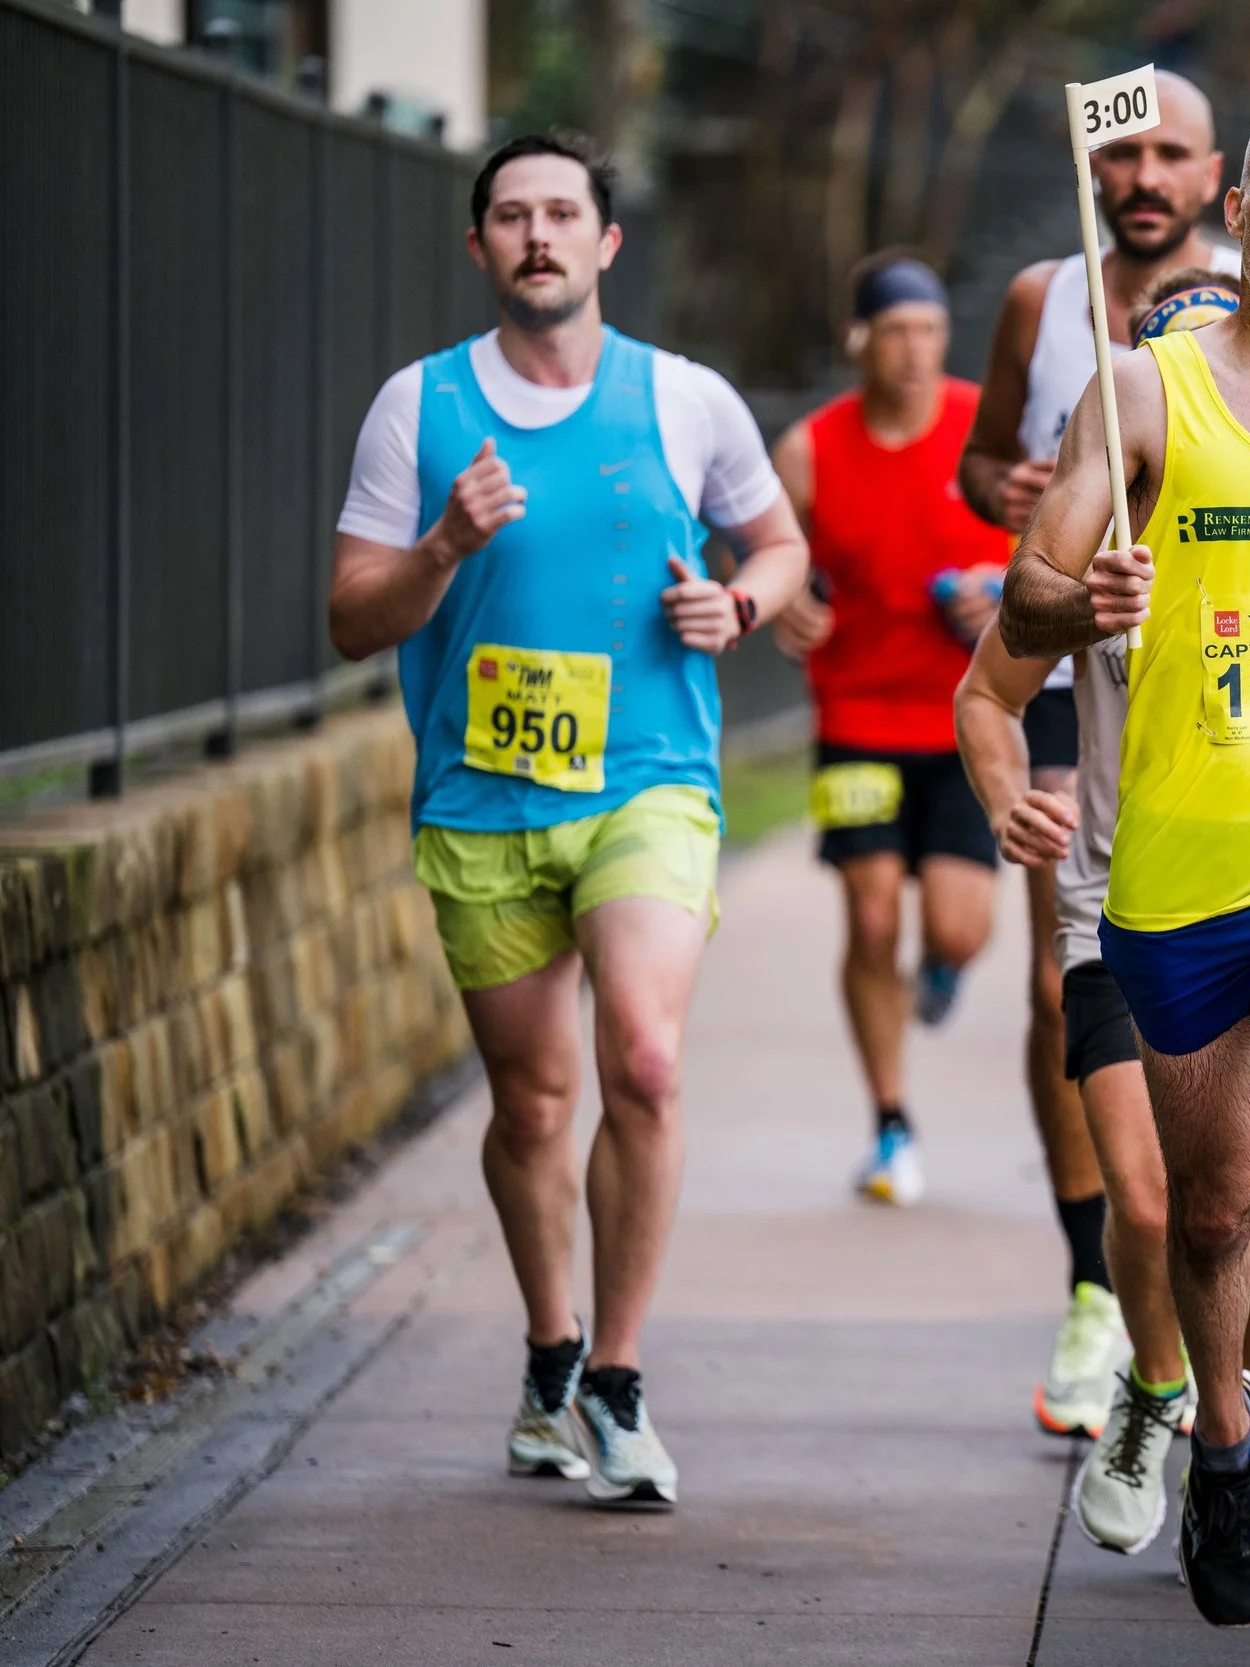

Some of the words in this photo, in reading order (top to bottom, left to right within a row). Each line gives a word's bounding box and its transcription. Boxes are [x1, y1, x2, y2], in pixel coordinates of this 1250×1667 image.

[1084, 86, 1148, 133] 3:00
[1216, 616, 1238, 625] Locke
[1220, 624, 1238, 633] Lord
[491, 703, 578, 754] 950
